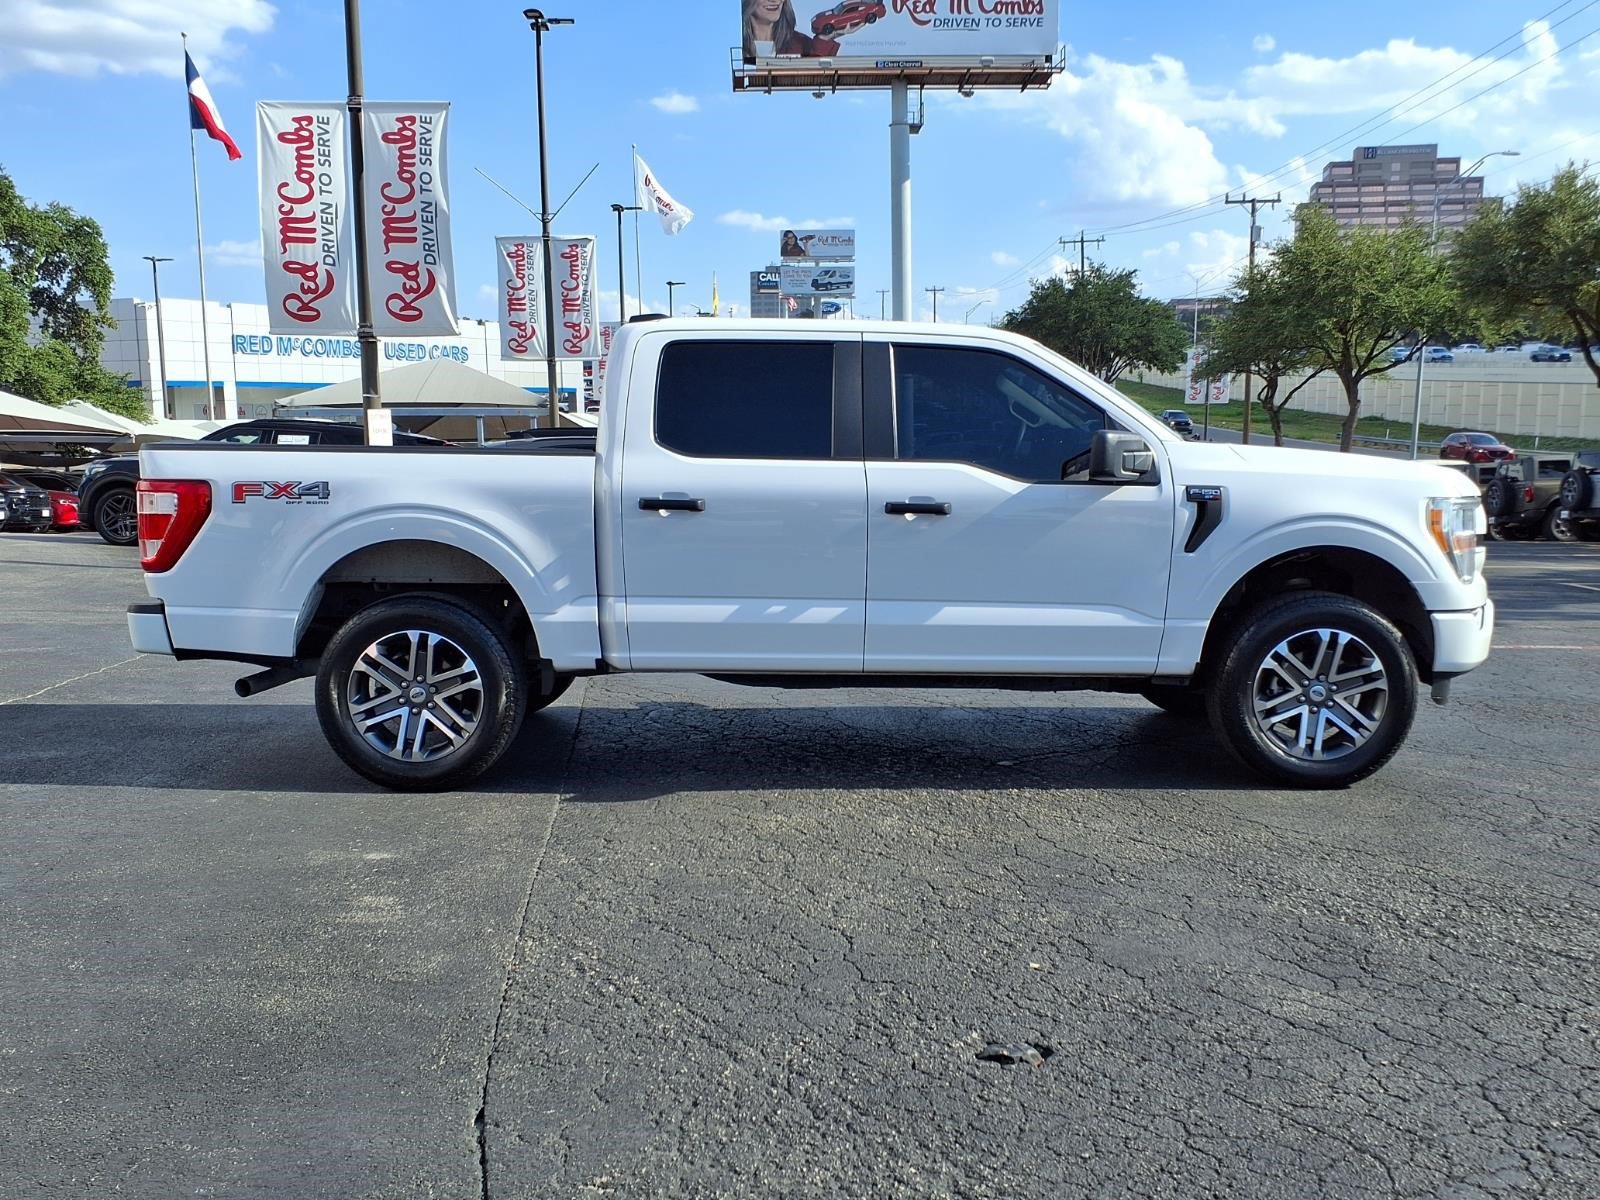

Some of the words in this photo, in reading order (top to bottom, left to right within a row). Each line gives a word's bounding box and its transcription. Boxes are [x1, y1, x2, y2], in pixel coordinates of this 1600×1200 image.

[933, 17, 981, 28] DRIVEN
[985, 17, 1002, 28] TO
[1005, 17, 1044, 28] SERVE
[317, 115, 332, 168] SERVE
[419, 115, 433, 167] SERVE
[277, 115, 317, 255] McCombs
[318, 172, 333, 196] TO
[381, 115, 418, 255] McCombs
[419, 171, 433, 195] TO
[320, 202, 337, 267] DRIVEN
[420, 201, 437, 266] DRIVEN
[526, 242, 534, 271] SERVE
[580, 243, 588, 273] SERVE
[283, 260, 335, 322] Red
[385, 260, 436, 322] Red
[506, 242, 527, 317] McCombs
[527, 273, 535, 286] TO
[560, 243, 581, 318] McCombs
[581, 274, 589, 287] TO
[527, 290, 537, 324] DRIVEN
[581, 290, 591, 324] DRIVEN
[234, 334, 273, 355] RED
[277, 336, 361, 359] McCOMBS
[384, 342, 426, 361] USED
[429, 344, 469, 363] CARS
[507, 321, 536, 354] Red
[562, 321, 590, 355] Red
[231, 480, 330, 504] FX4
